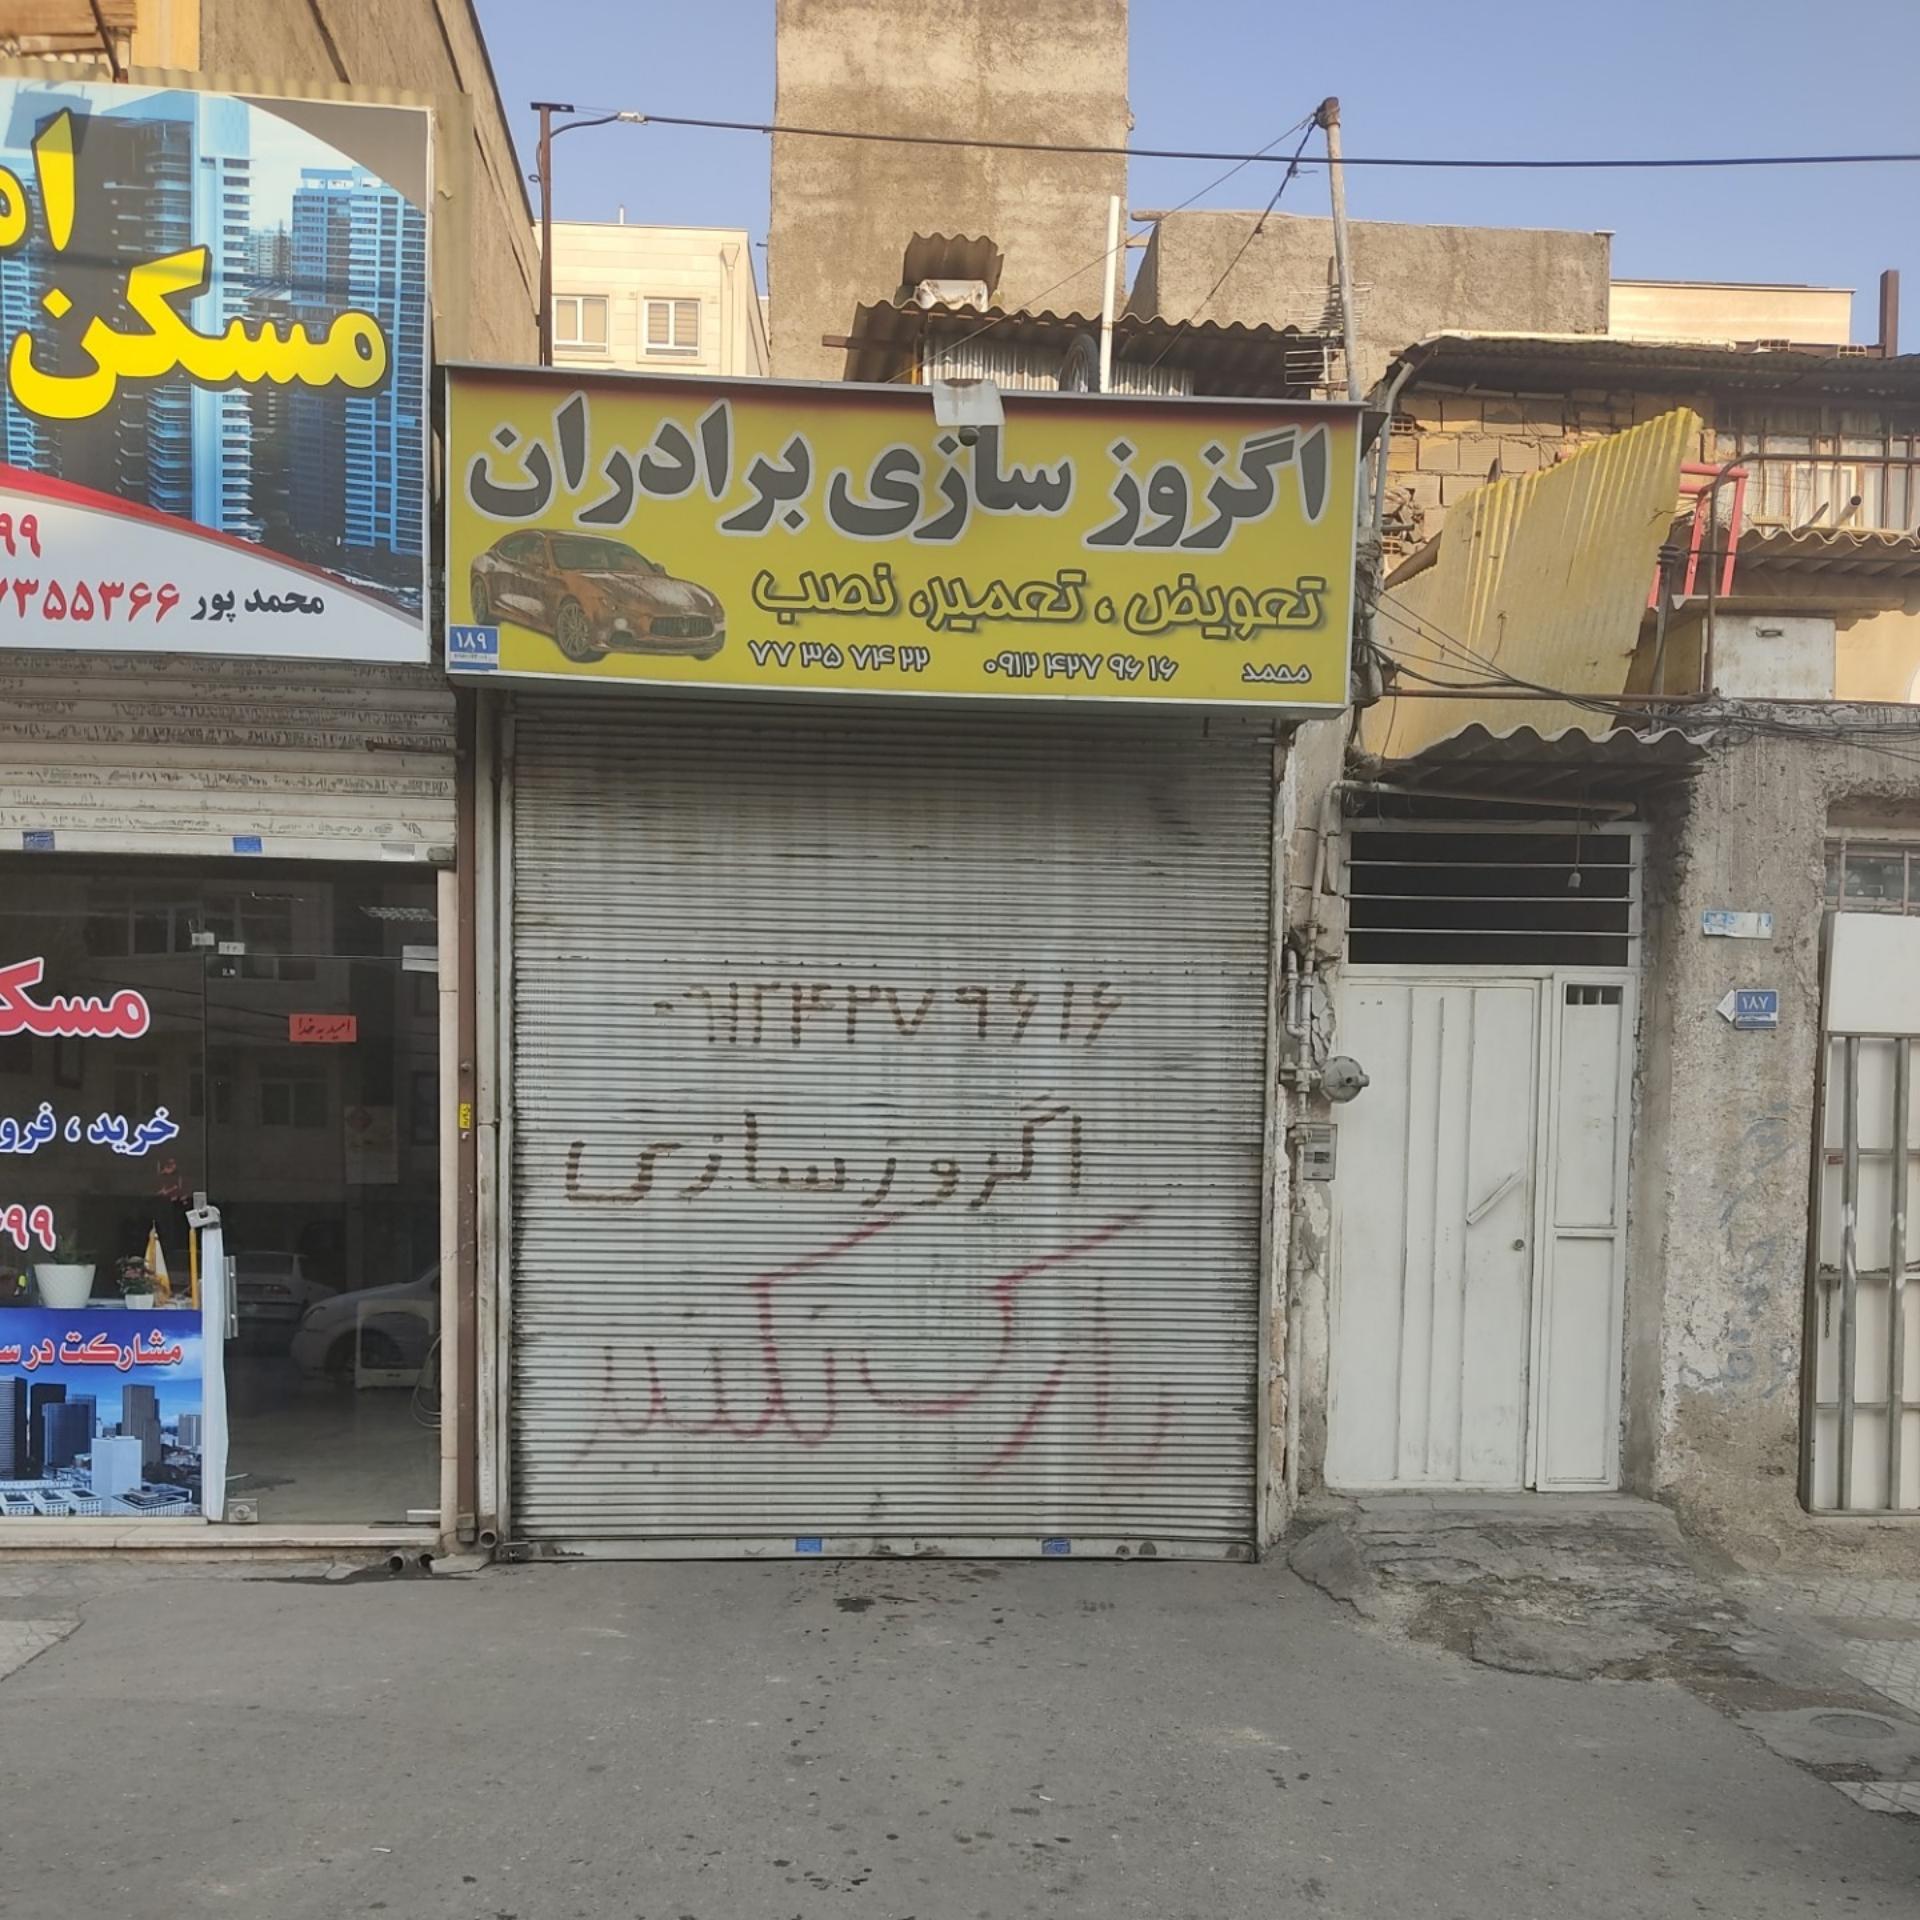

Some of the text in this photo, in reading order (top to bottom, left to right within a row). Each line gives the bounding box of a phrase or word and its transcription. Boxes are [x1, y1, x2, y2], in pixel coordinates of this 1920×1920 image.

[8, 244, 390, 420] مسکن
[467, 391, 811, 532] برادران
[1084, 424, 1331, 552] اگزوز
[189, 592, 235, 624] پور
[245, 590, 325, 616] محمد
[752, 562, 900, 626] نصب
[1124, 572, 1328, 642] تعویض
[455, 631, 488, 651] ۱۸۹
[1242, 660, 1312, 684] محمد
[1742, 995, 1770, 1010] ۱۸۷
[87, 1106, 180, 1156] خرید
[0, 1204, 57, 1252] ۹۹
[23, 1338, 56, 1370] در
[59, 1328, 184, 1371] مشارکت
